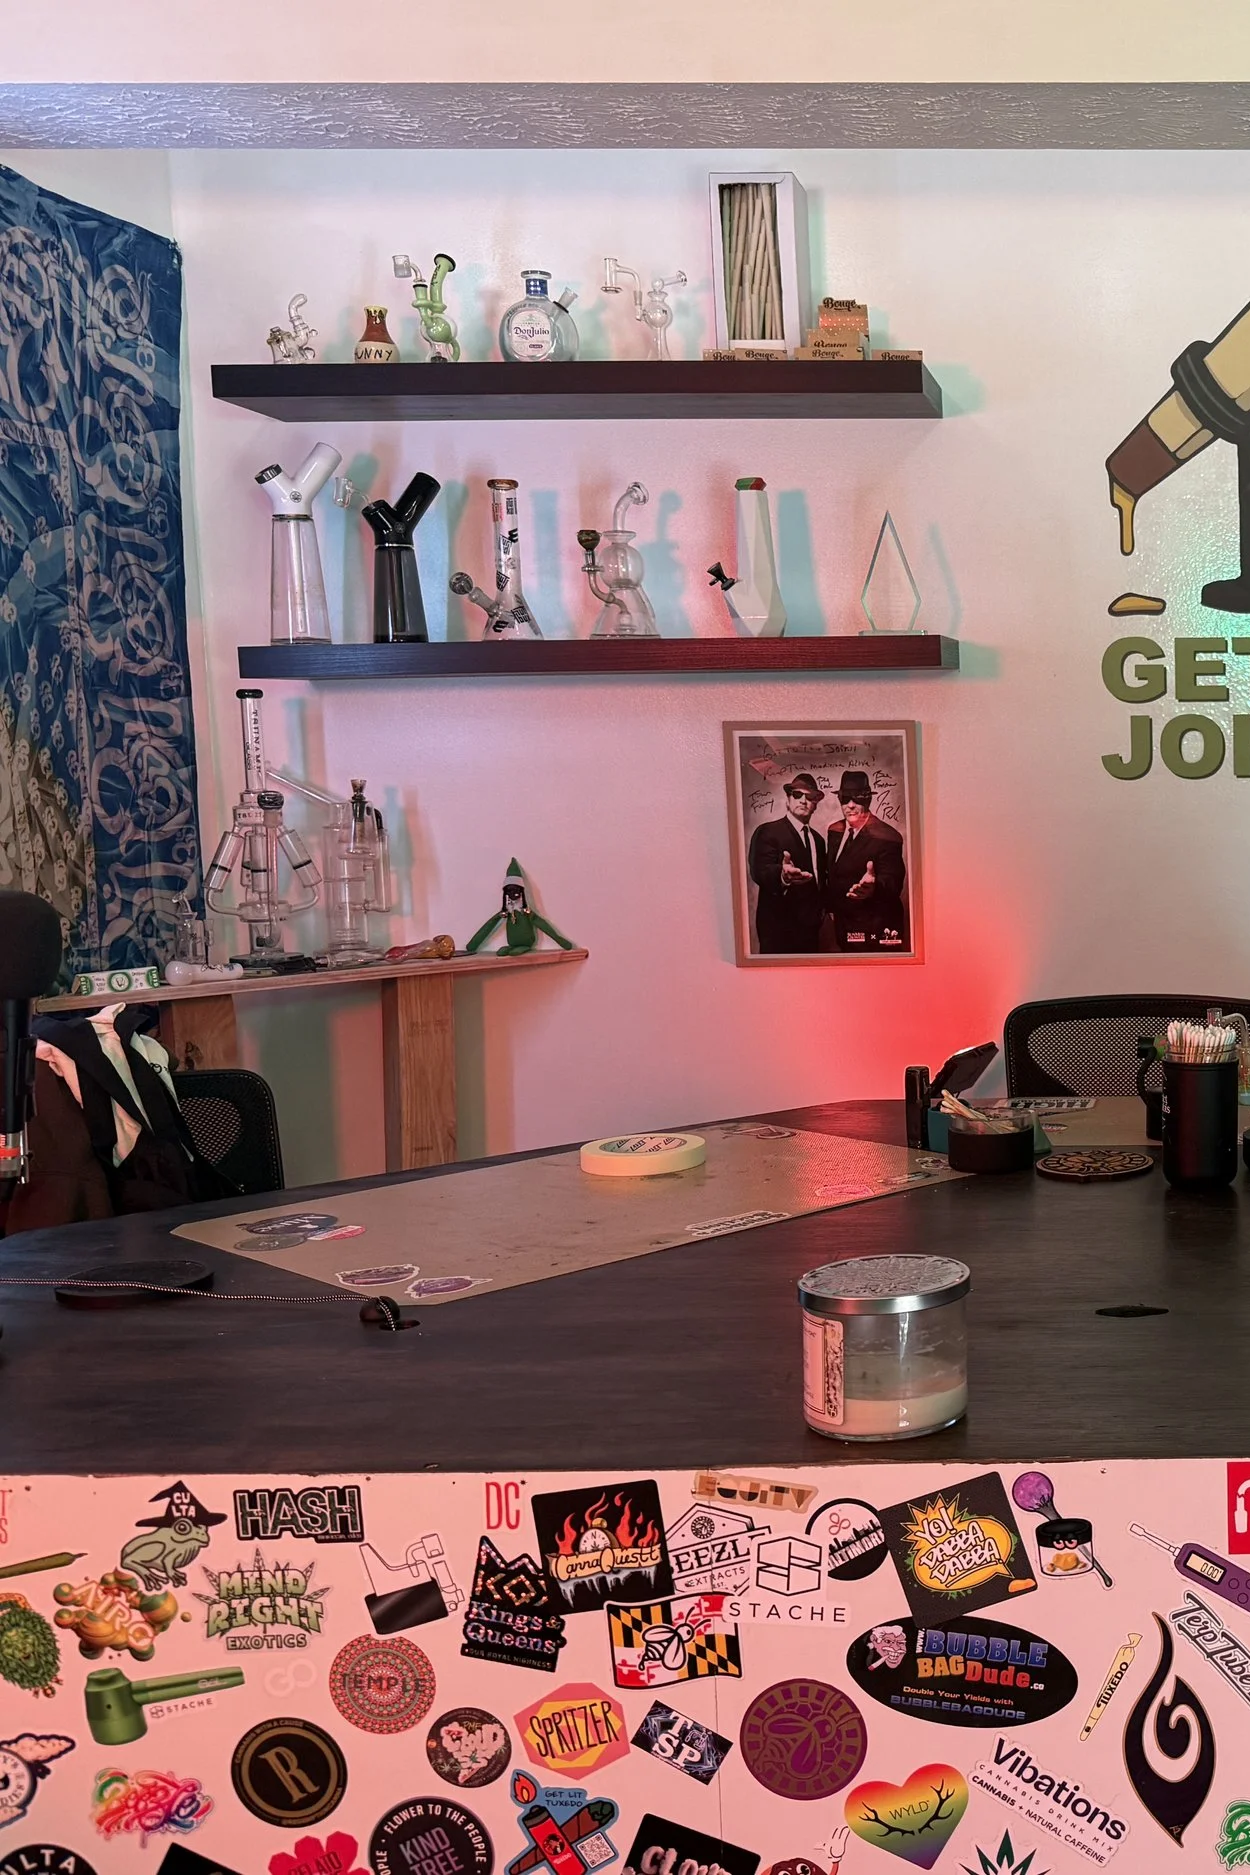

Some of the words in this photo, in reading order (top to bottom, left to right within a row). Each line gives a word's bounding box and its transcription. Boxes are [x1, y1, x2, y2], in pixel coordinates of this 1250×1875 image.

[171, 1504, 196, 1518] LTA
[173, 1491, 191, 1504] CU
[236, 1488, 359, 1538] HASH
[485, 1481, 521, 1530] DC
[919, 1520, 985, 1569] DABBA
[218, 1569, 308, 1598] MIND
[684, 1566, 746, 1588] EXTRACTS
[72, 1581, 155, 1648] AIRO
[206, 1597, 324, 1639] RIGHT
[469, 1600, 544, 1634] Kings
[546, 1615, 562, 1630] &
[728, 1601, 847, 1624] STACHE
[226, 1633, 308, 1650] EXOTICS
[465, 1622, 556, 1654] Queens
[916, 1627, 927, 1654] www.
[924, 1629, 1050, 1669] BUBBLE
[487, 1650, 512, 1663] ROYAL
[513, 1654, 552, 1669] HIGHNESS
[265, 1657, 318, 1698] GO
[343, 1672, 426, 1695] TEMPLE
[1095, 1661, 1131, 1708] TUXEDO
[166, 1697, 214, 1714] STACHE
[889, 1694, 1027, 1720] BUBBLEBAGDUDE
[903, 1686, 936, 1697] Double
[938, 1690, 962, 1700] Your
[963, 1693, 992, 1705] Yields
[993, 1697, 1014, 1707] with
[528, 1700, 620, 1760] SPRITZER
[257, 1746, 321, 1804] R
[992, 1738, 1127, 1841] Vibations
[544, 1791, 564, 1799] GET
[567, 1791, 584, 1799] LIT
[545, 1799, 584, 1808] TUXEDO
[888, 1801, 929, 1821] WYLD
[979, 1764, 1041, 1806] CANNABIS
[1048, 1807, 1085, 1834] DRINK
[1092, 1836, 1115, 1852] MIX
[383, 1804, 425, 1835] FLOWER
[428, 1803, 443, 1815] TO
[445, 1807, 466, 1827] THE
[463, 1820, 489, 1864] PEOPLE
[972, 1775, 1017, 1807] CANNABIS
[1024, 1808, 1063, 1837] NATURAL
[1064, 1833, 1107, 1864] CAFFEINE
[398, 1826, 452, 1866] KIND
[409, 1847, 466, 1875] TREE
